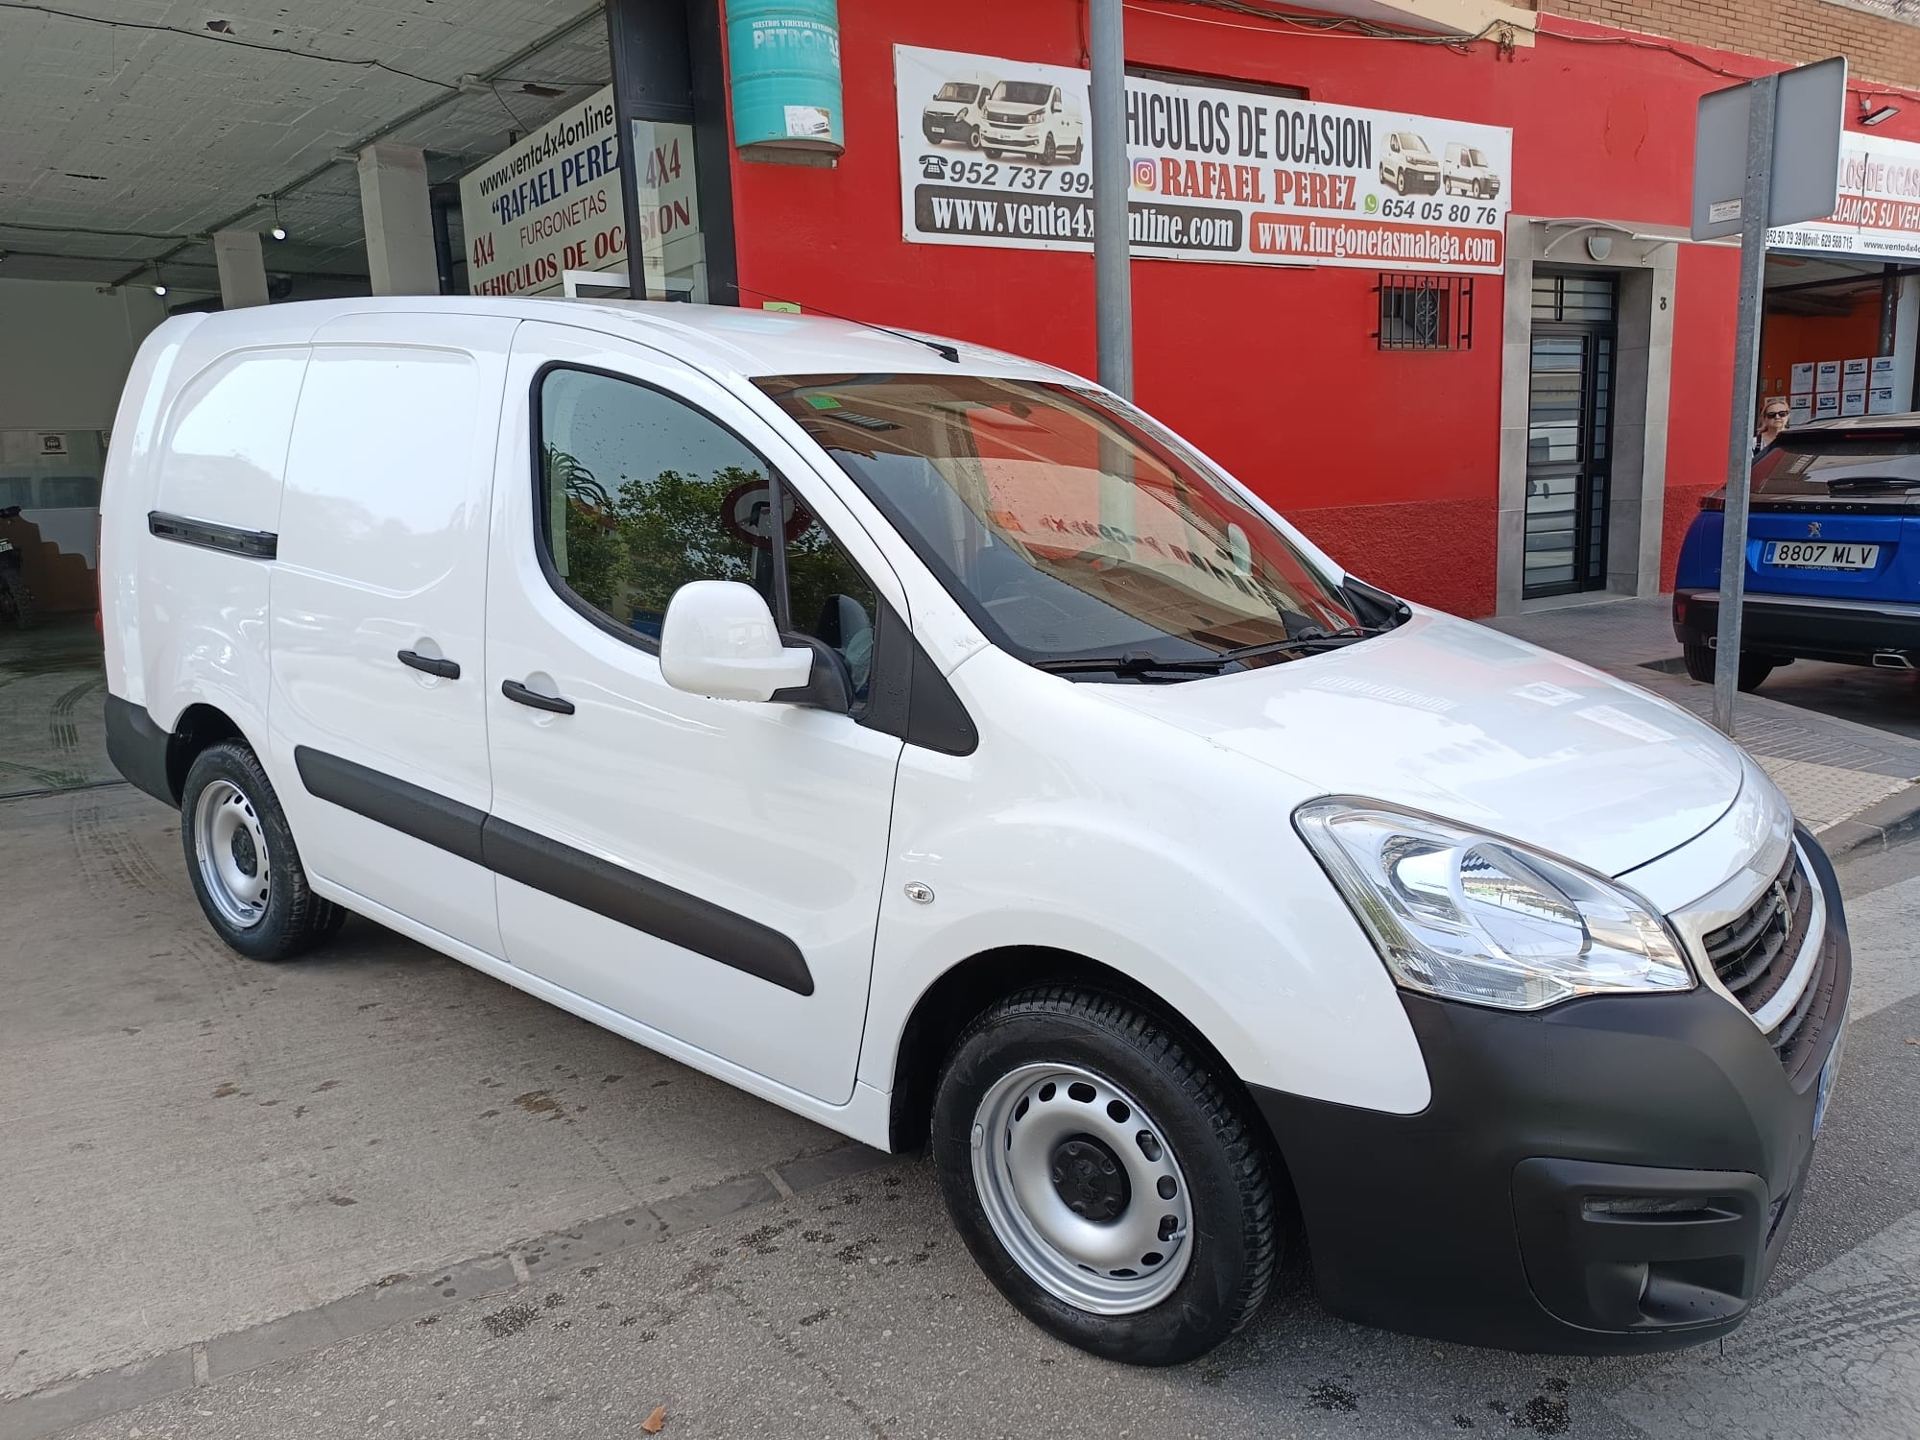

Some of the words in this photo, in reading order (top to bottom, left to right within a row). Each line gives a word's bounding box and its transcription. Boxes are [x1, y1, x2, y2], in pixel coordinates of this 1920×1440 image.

[1088, 85, 1231, 156] HICULOS
[1238, 105, 1268, 160] DE
[1275, 109, 1372, 170] OCASION
[646, 138, 682, 190] 4X4
[949, 160, 999, 187] 952
[1008, 166, 1053, 191] 737
[1059, 171, 1095, 195] 99
[1160, 157, 1266, 204] RAFAEL
[1274, 169, 1357, 211] PEREZ
[1839, 157, 1864, 190] LOS
[1866, 161, 1884, 192] DE
[1886, 166, 1920, 198] OCAS
[519, 189, 608, 249] FURGONETAS
[1382, 199, 1415, 220] 654
[1421, 202, 1444, 221] 05
[1448, 205, 1471, 224] 80
[1476, 206, 1497, 225] 76
[1879, 200, 1895, 227] SU
[473, 231, 495, 268] 4X4
[1258, 221, 1496, 263] www.furgonetasmalaga.com
[474, 252, 558, 296] VEHICULOS
[563, 240, 590, 270] DE
[1779, 545, 1828, 562] 8807
[1832, 546, 1873, 564] MLV
